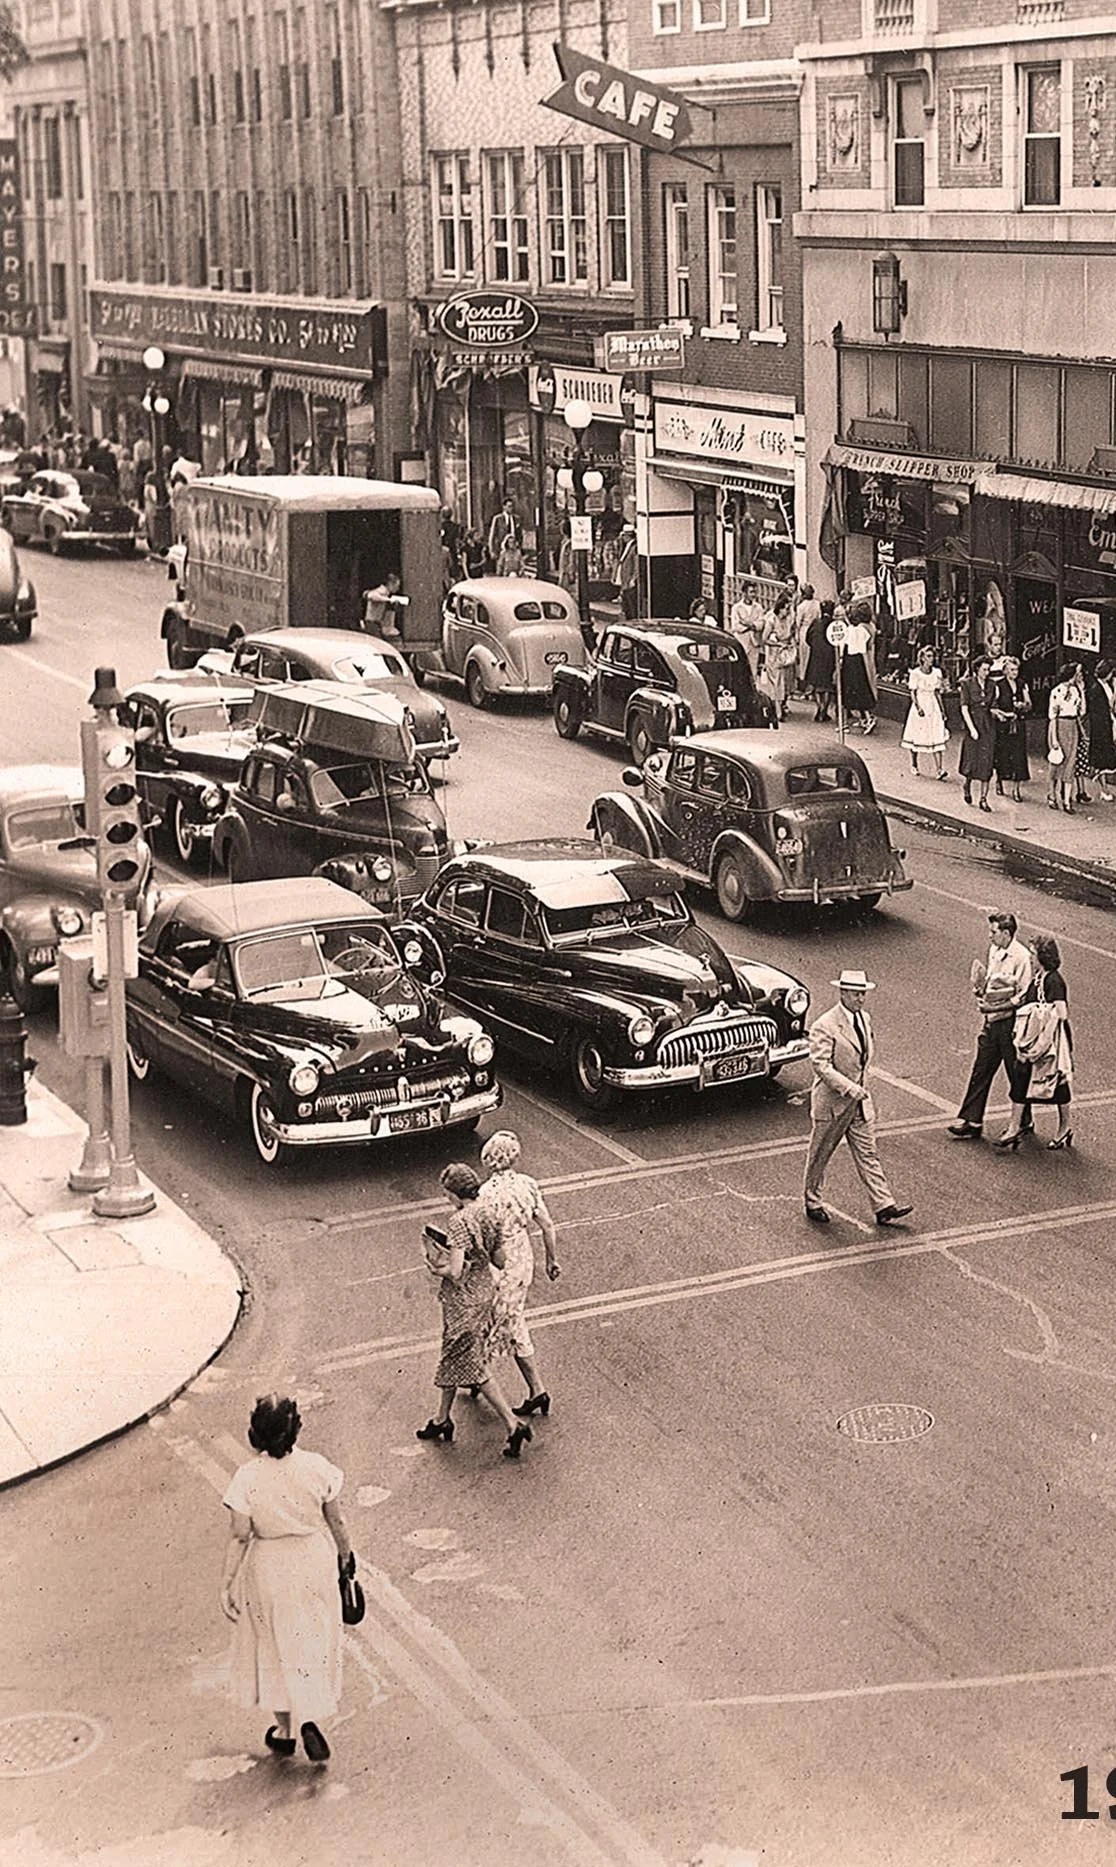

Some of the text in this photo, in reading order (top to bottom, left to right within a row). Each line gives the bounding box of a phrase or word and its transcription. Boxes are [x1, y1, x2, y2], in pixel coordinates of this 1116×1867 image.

[574, 70, 680, 140] CAFE
[0, 155, 21, 301] MAYERS
[213, 312, 262, 342] STORES
[455, 299, 524, 329] Rexall
[468, 326, 515, 342] DRUGS
[628, 352, 662, 366] Beer
[888, 459, 940, 477] SLIPPER
[946, 466, 976, 480] SHOP
